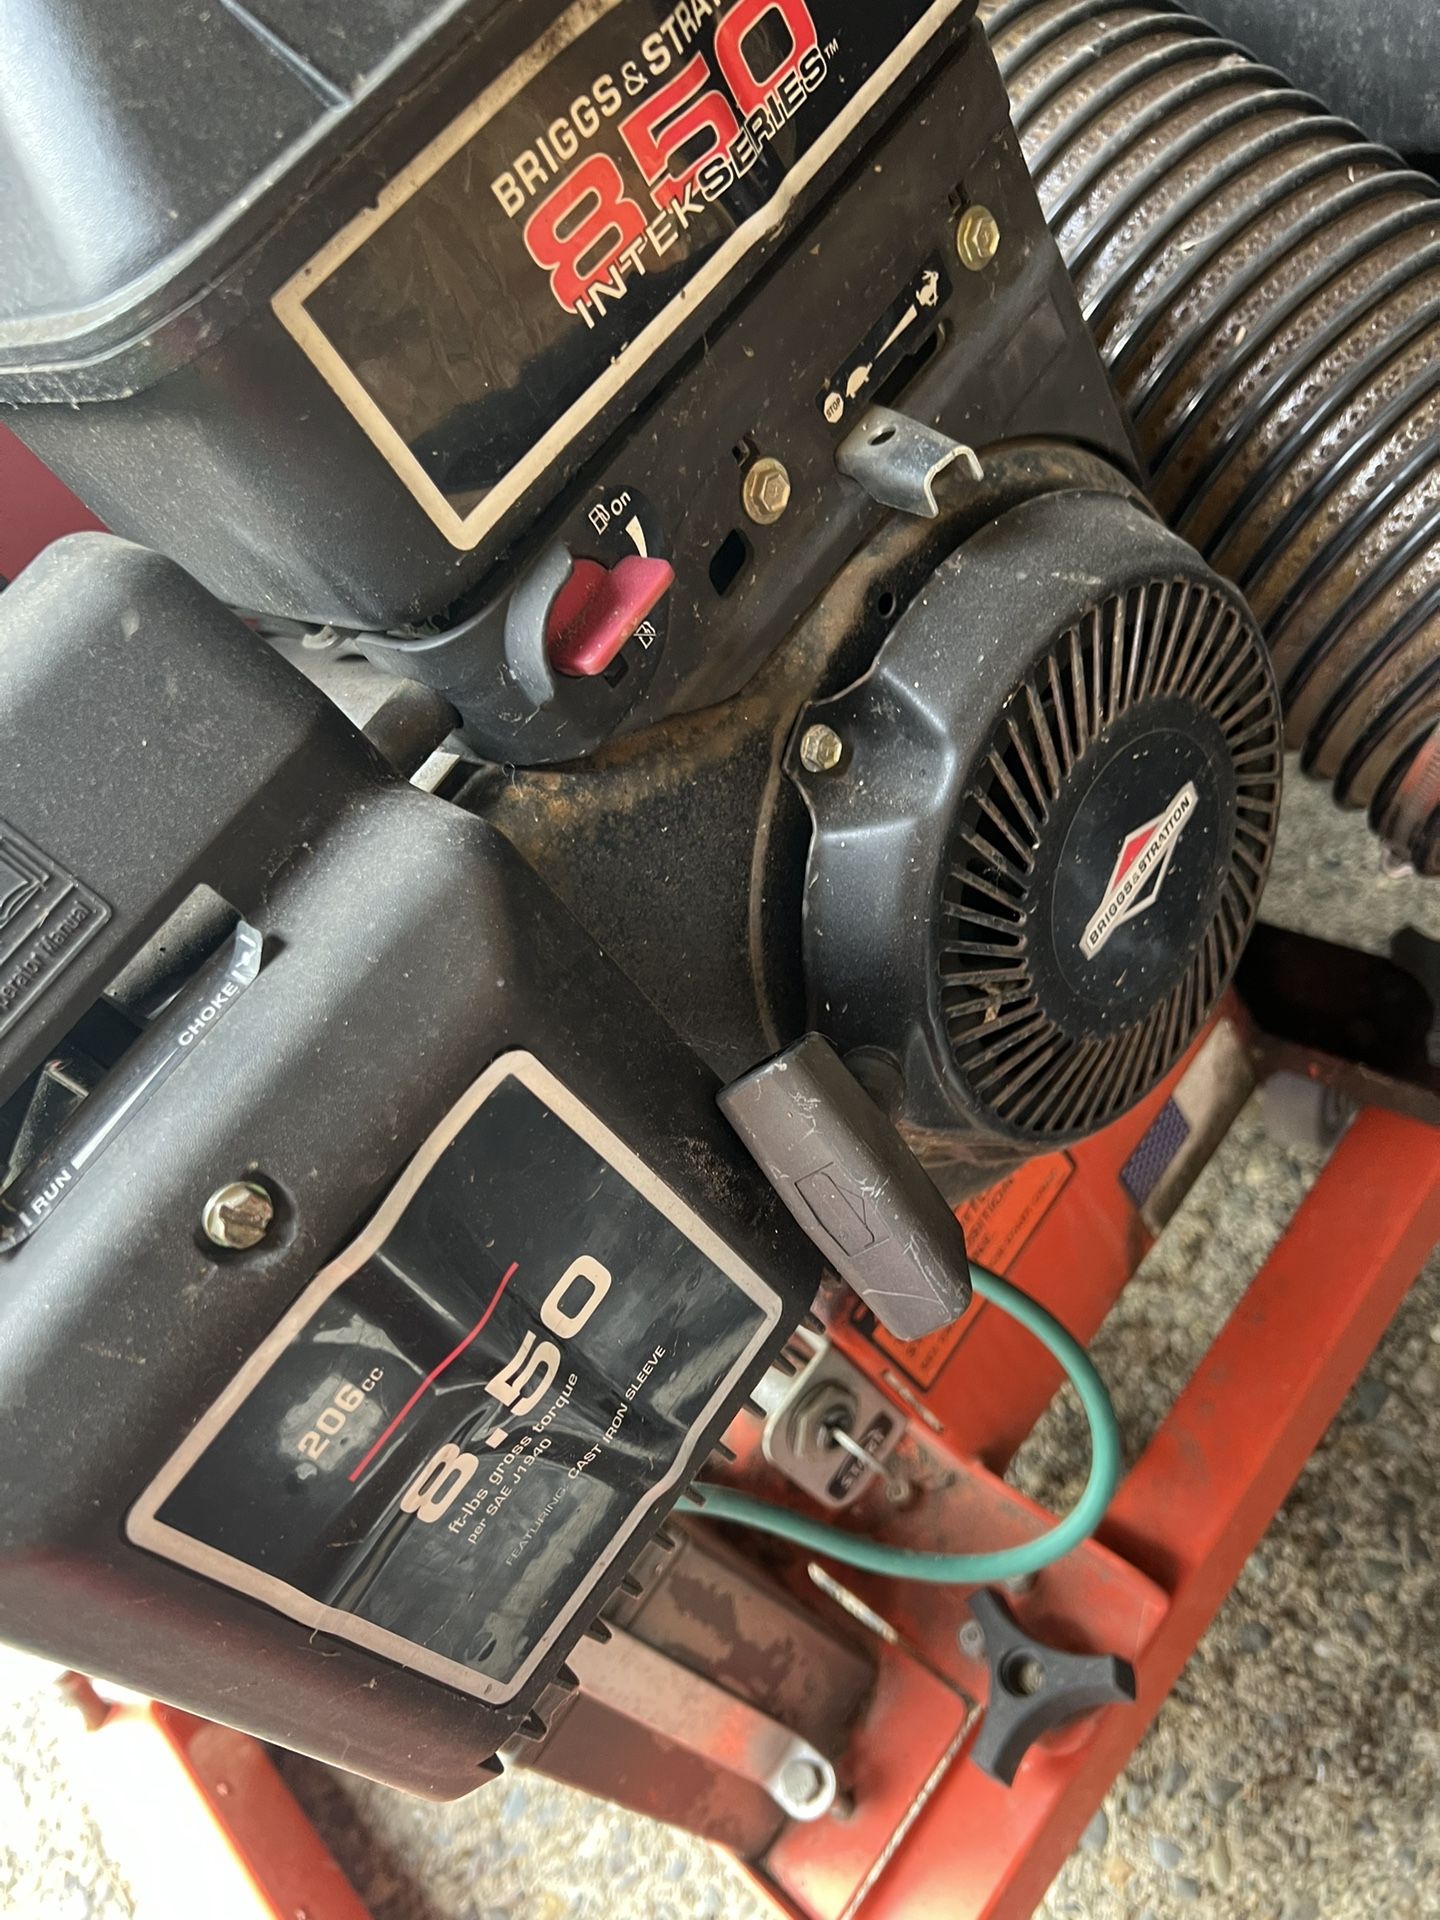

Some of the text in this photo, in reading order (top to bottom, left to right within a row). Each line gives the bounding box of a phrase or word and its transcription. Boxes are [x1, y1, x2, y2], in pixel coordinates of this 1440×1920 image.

[490, 0, 721, 218] BRIGGS & STRA
[523, 0, 818, 314] 850
[574, 183, 705, 329] INTEK
[699, 43, 828, 202] SERIES
[826, 397, 841, 418] STOP
[610, 491, 631, 517] on
[41, 900, 90, 956] Manual
[1089, 880, 1133, 945] BRIGGS
[1138, 796, 1190, 874] STRATTON
[177, 982, 238, 1047] CHOKE
[31, 1169, 72, 1215] RUN
[400, 1254, 613, 1524] 8.50
[448, 1373, 579, 1535] ft-lbs gross torque
[567, 1443, 602, 1480] CAST
[602, 1402, 629, 1444] IRON
[624, 1345, 667, 1402] SLEEVE
[467, 1438, 552, 1545] per SAE J1940
